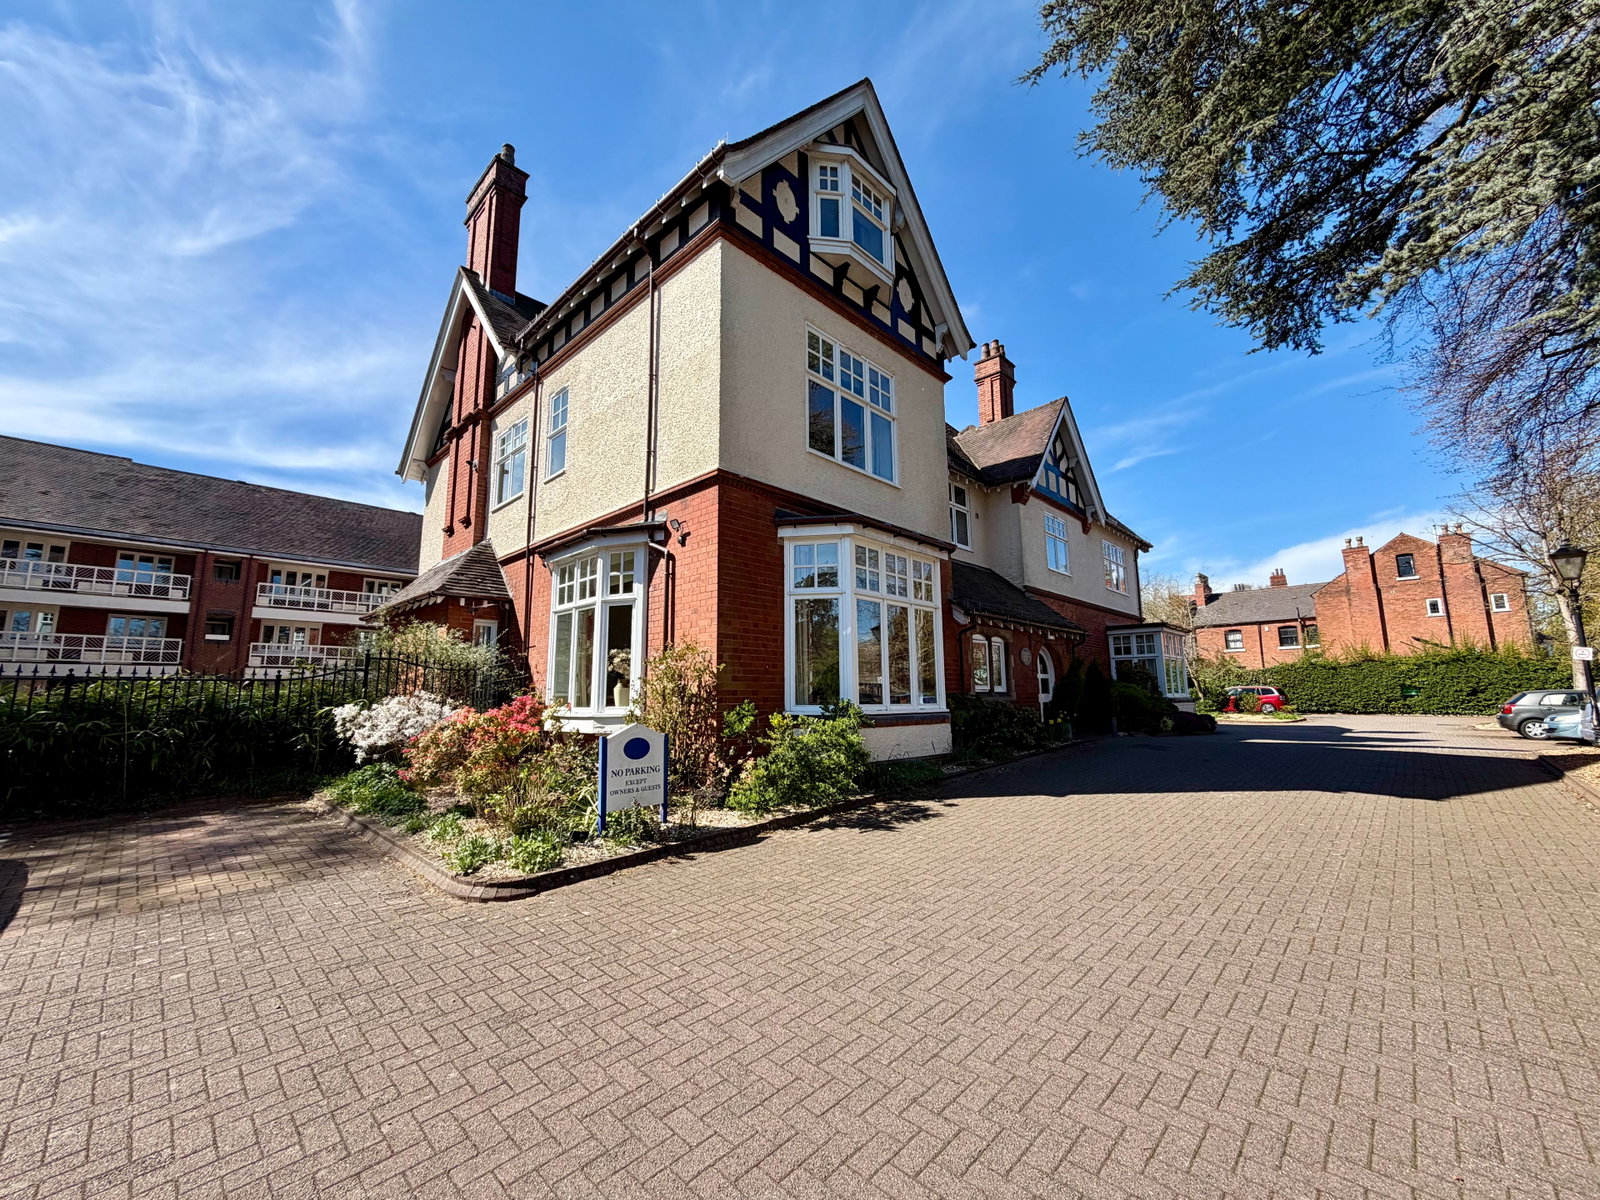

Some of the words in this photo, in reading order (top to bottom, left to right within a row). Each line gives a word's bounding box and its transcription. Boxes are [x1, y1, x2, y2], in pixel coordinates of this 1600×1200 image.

[611, 769, 624, 778] NO
[625, 765, 661, 776] PARKING
[625, 778, 647, 786] EXCEPT
[610, 787, 634, 796] OWNERS
[641, 784, 661, 792] GUESTS
